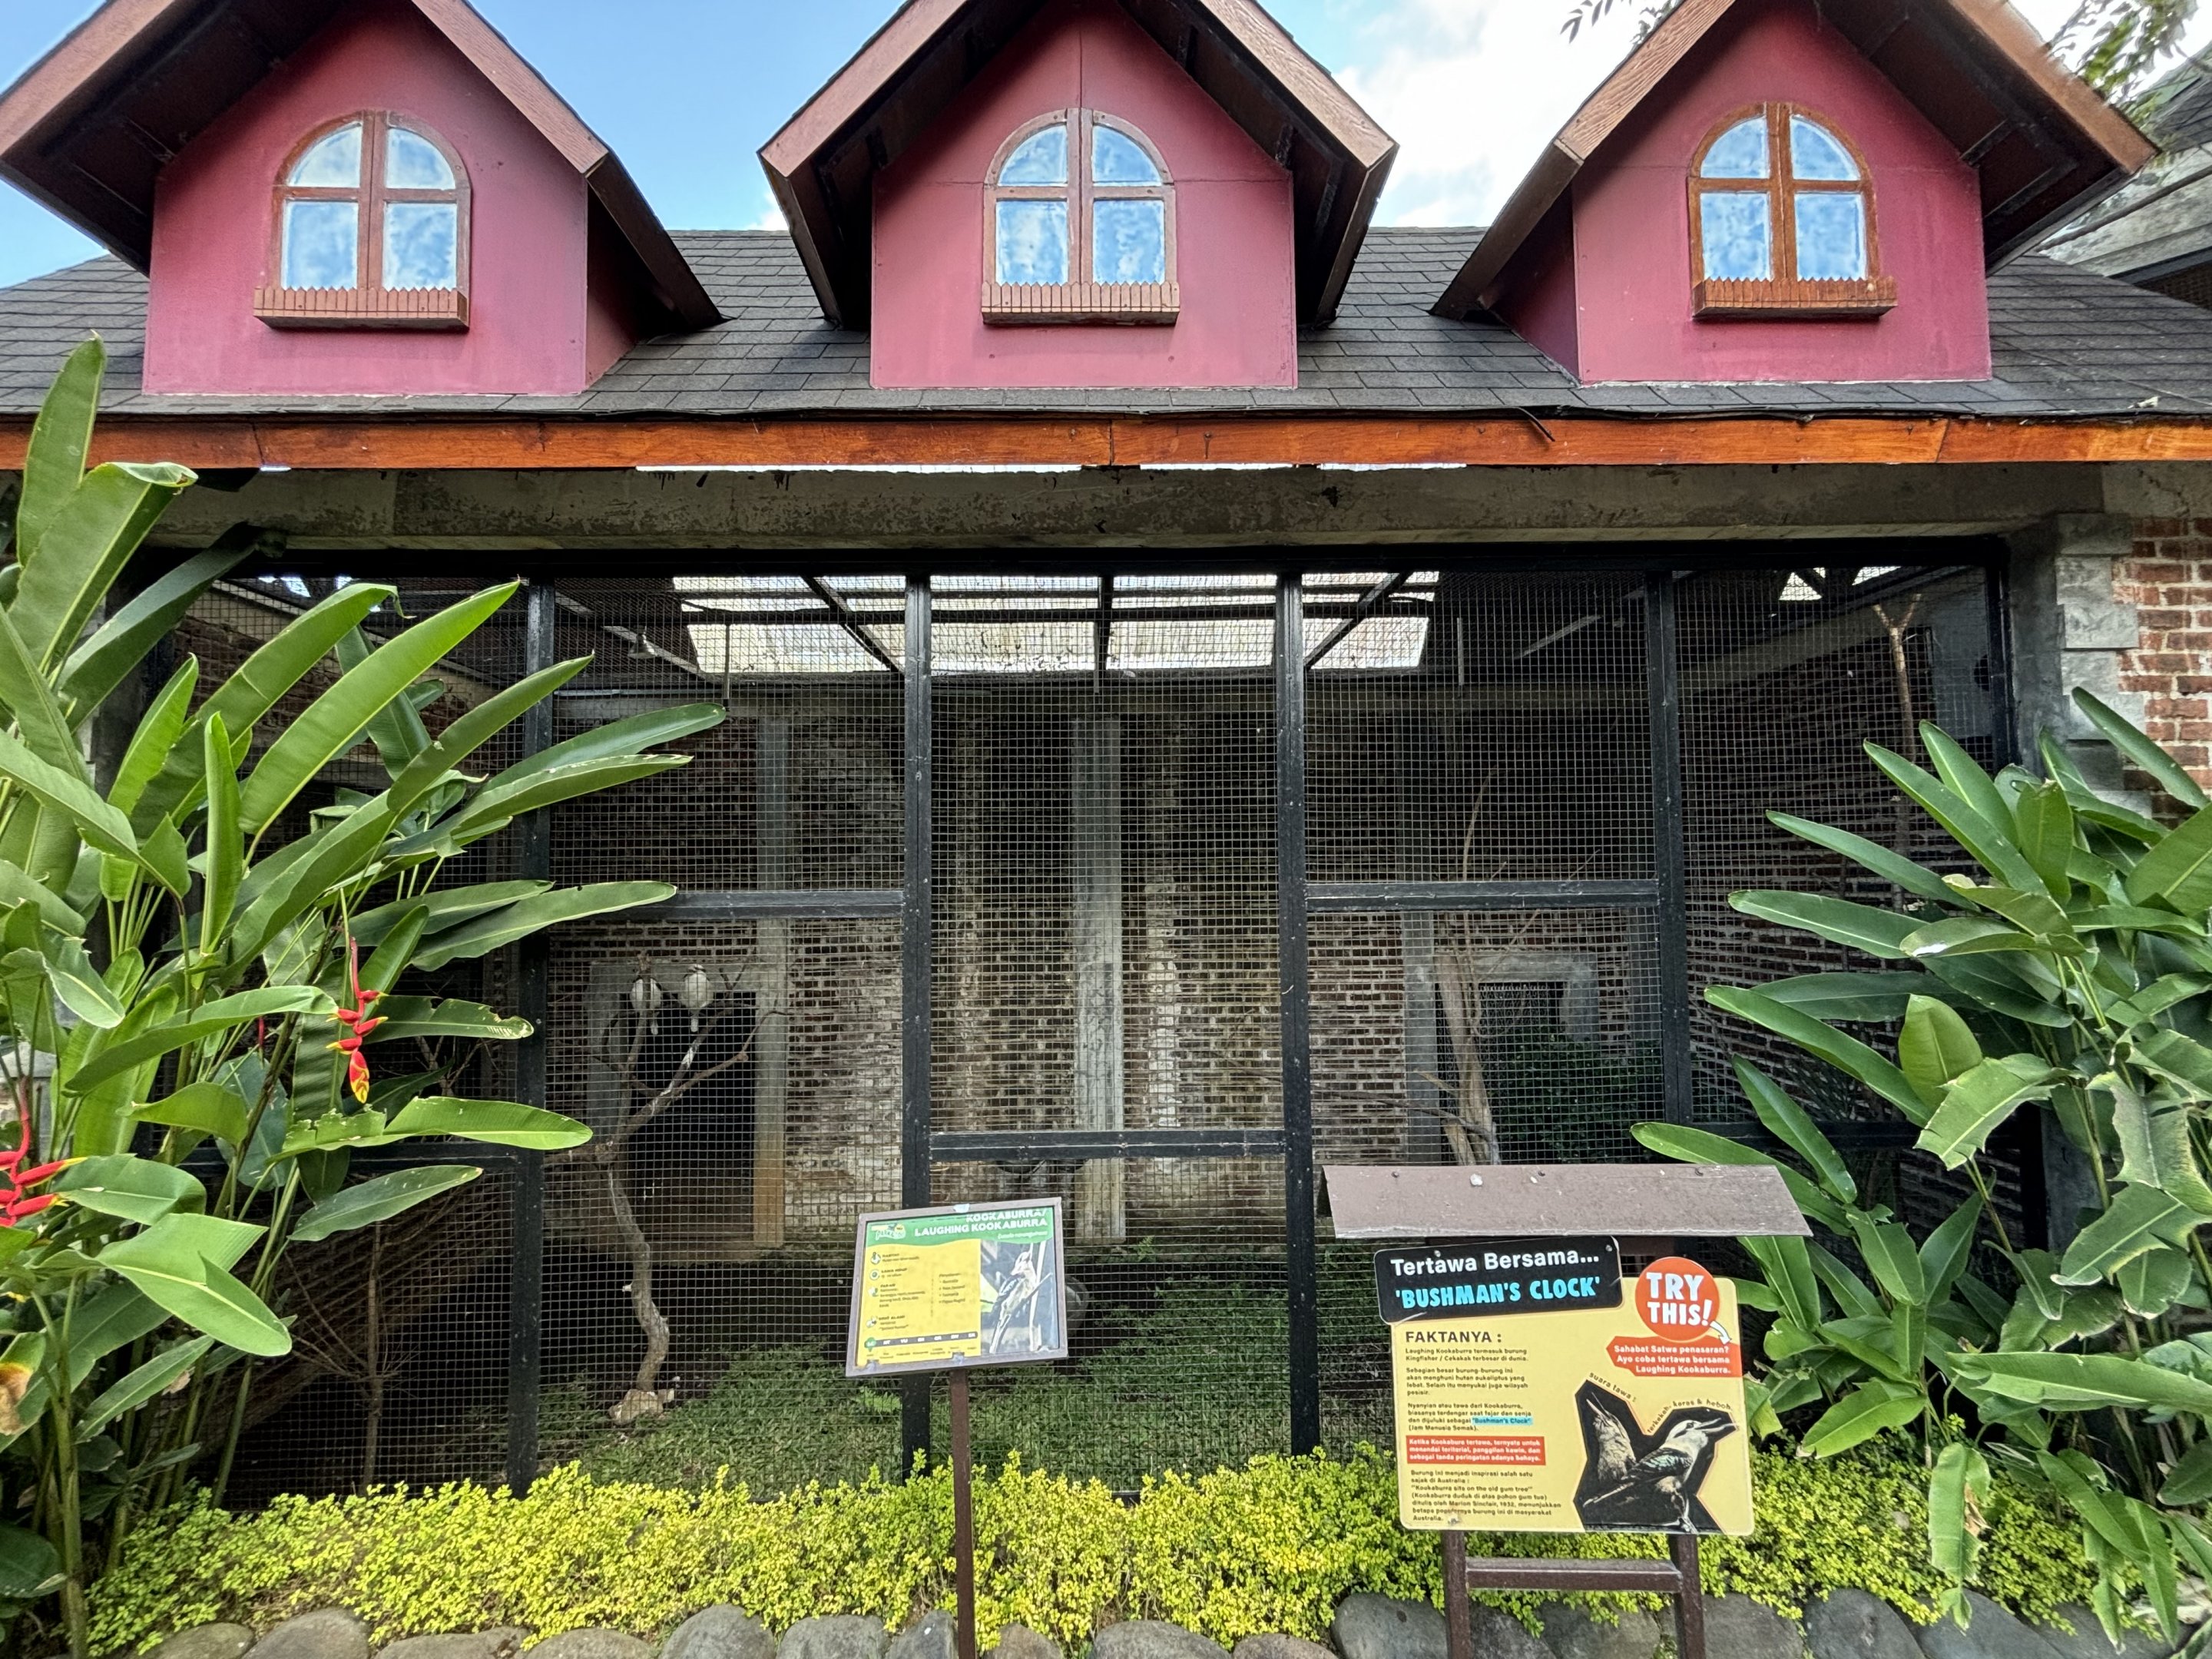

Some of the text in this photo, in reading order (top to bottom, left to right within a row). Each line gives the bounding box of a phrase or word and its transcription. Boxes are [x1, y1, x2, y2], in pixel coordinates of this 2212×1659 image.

[915, 1225, 969, 1237] LAUGHING
[972, 1218, 1048, 1232] KOOKABURRA
[1390, 1250, 1599, 1277] Tertawa Bersama...
[1396, 1277, 1600, 1309] 'BUSHMAN'S CLOCK'
[1646, 1273, 1704, 1301] TRY
[1647, 1300, 1712, 1326] THIS!
[1406, 1331, 1492, 1343] FAKTANYA
[1617, 1356, 1633, 1365] Ayo
[1680, 1346, 1729, 1354] penasaran?
[1636, 1366, 1730, 1374] Laughing Kookaburra.
[1589, 1373, 1611, 1388] suara
[1613, 1385, 1632, 1400] tawa
